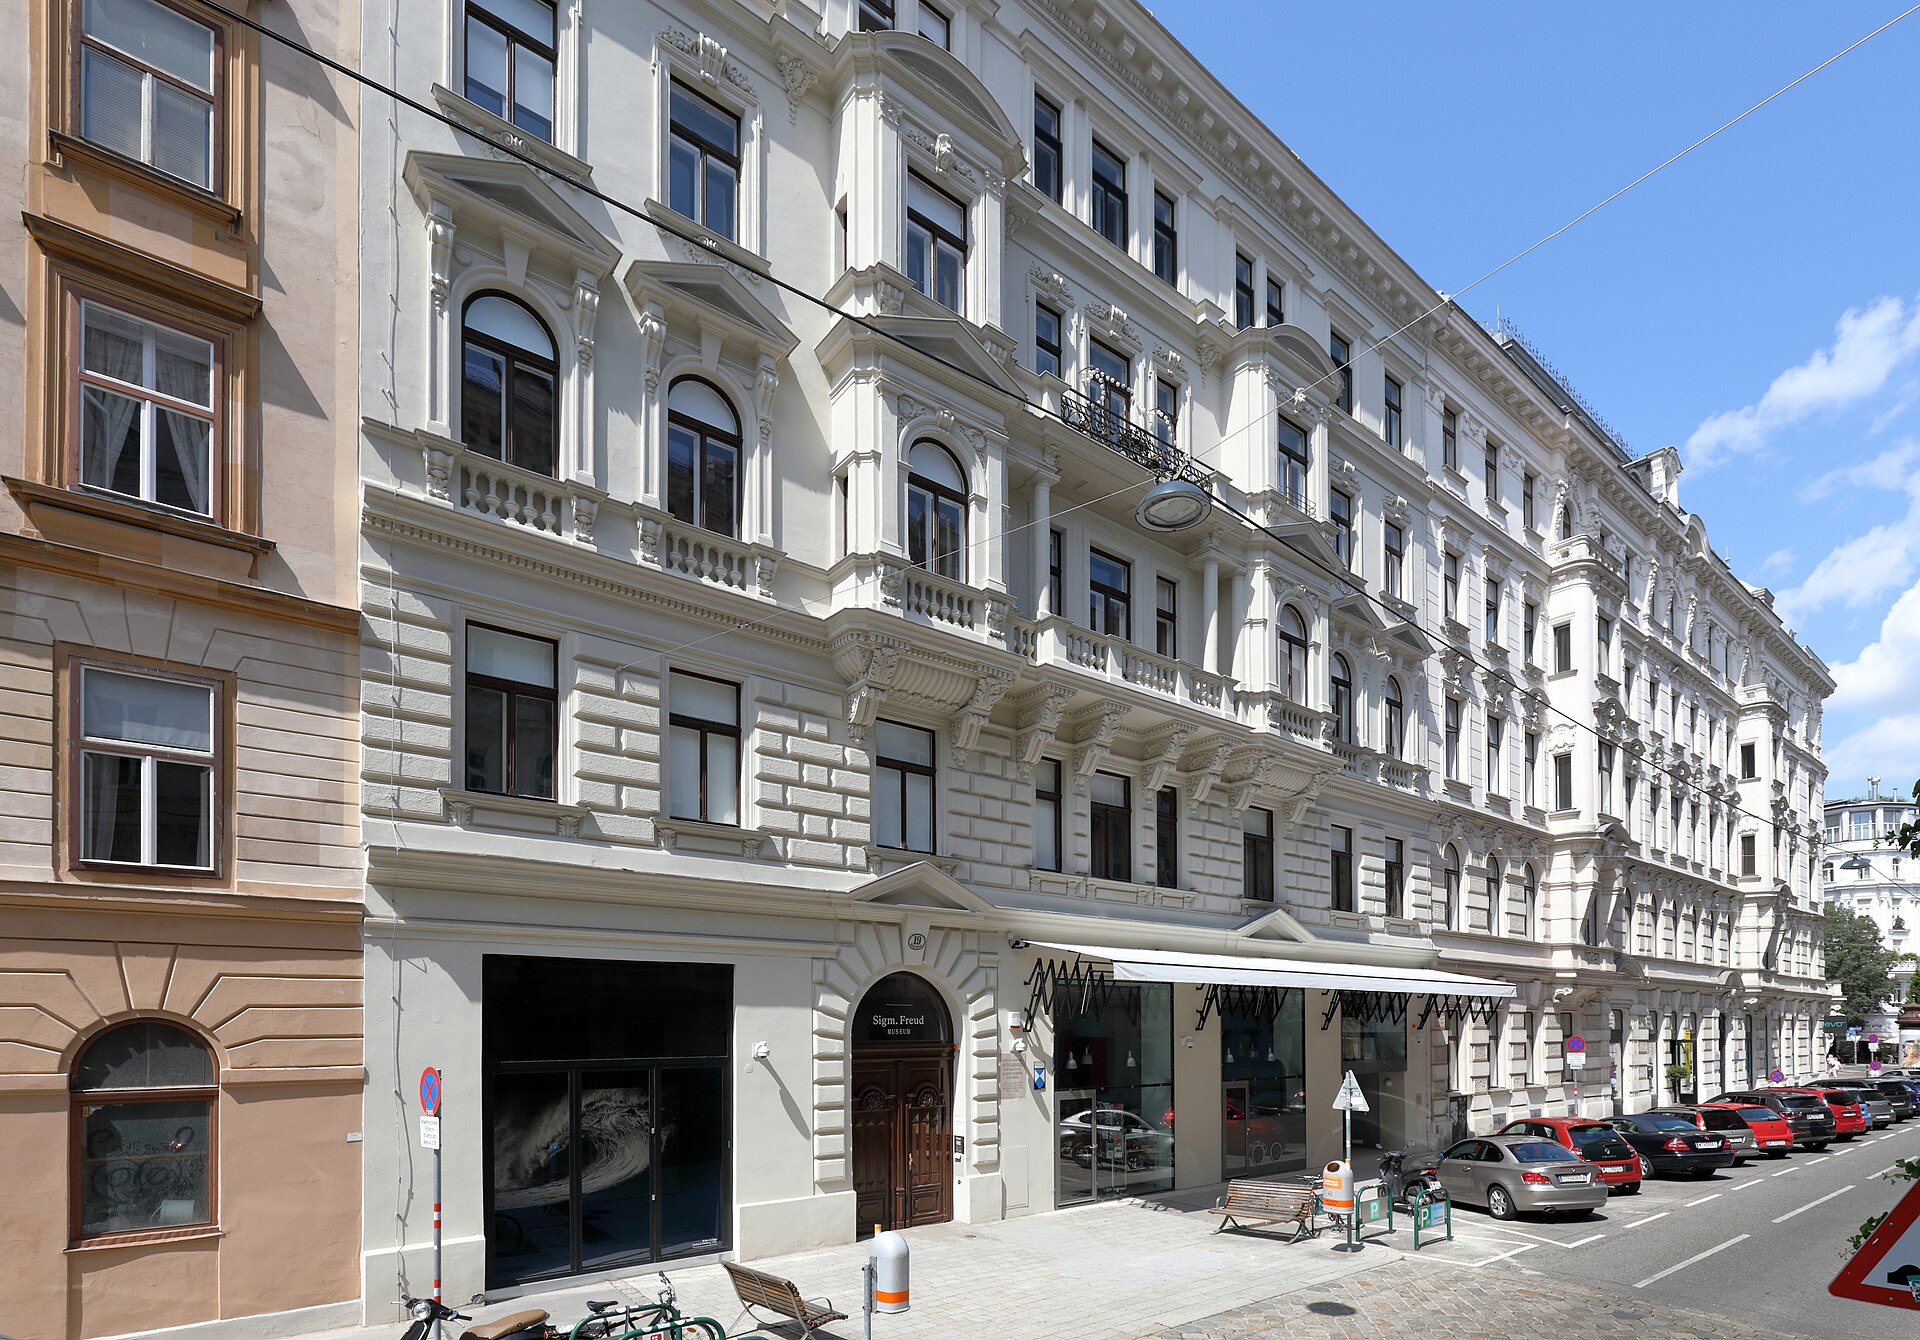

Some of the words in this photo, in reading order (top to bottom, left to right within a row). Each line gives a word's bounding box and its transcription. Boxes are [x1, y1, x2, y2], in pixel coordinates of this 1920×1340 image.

[913, 936, 922, 945] 19
[872, 1015, 898, 1028] Sigm.
[900, 1015, 925, 1025] Freud
[1371, 1202, 1378, 1219] P
[1421, 1208, 1429, 1228] P
